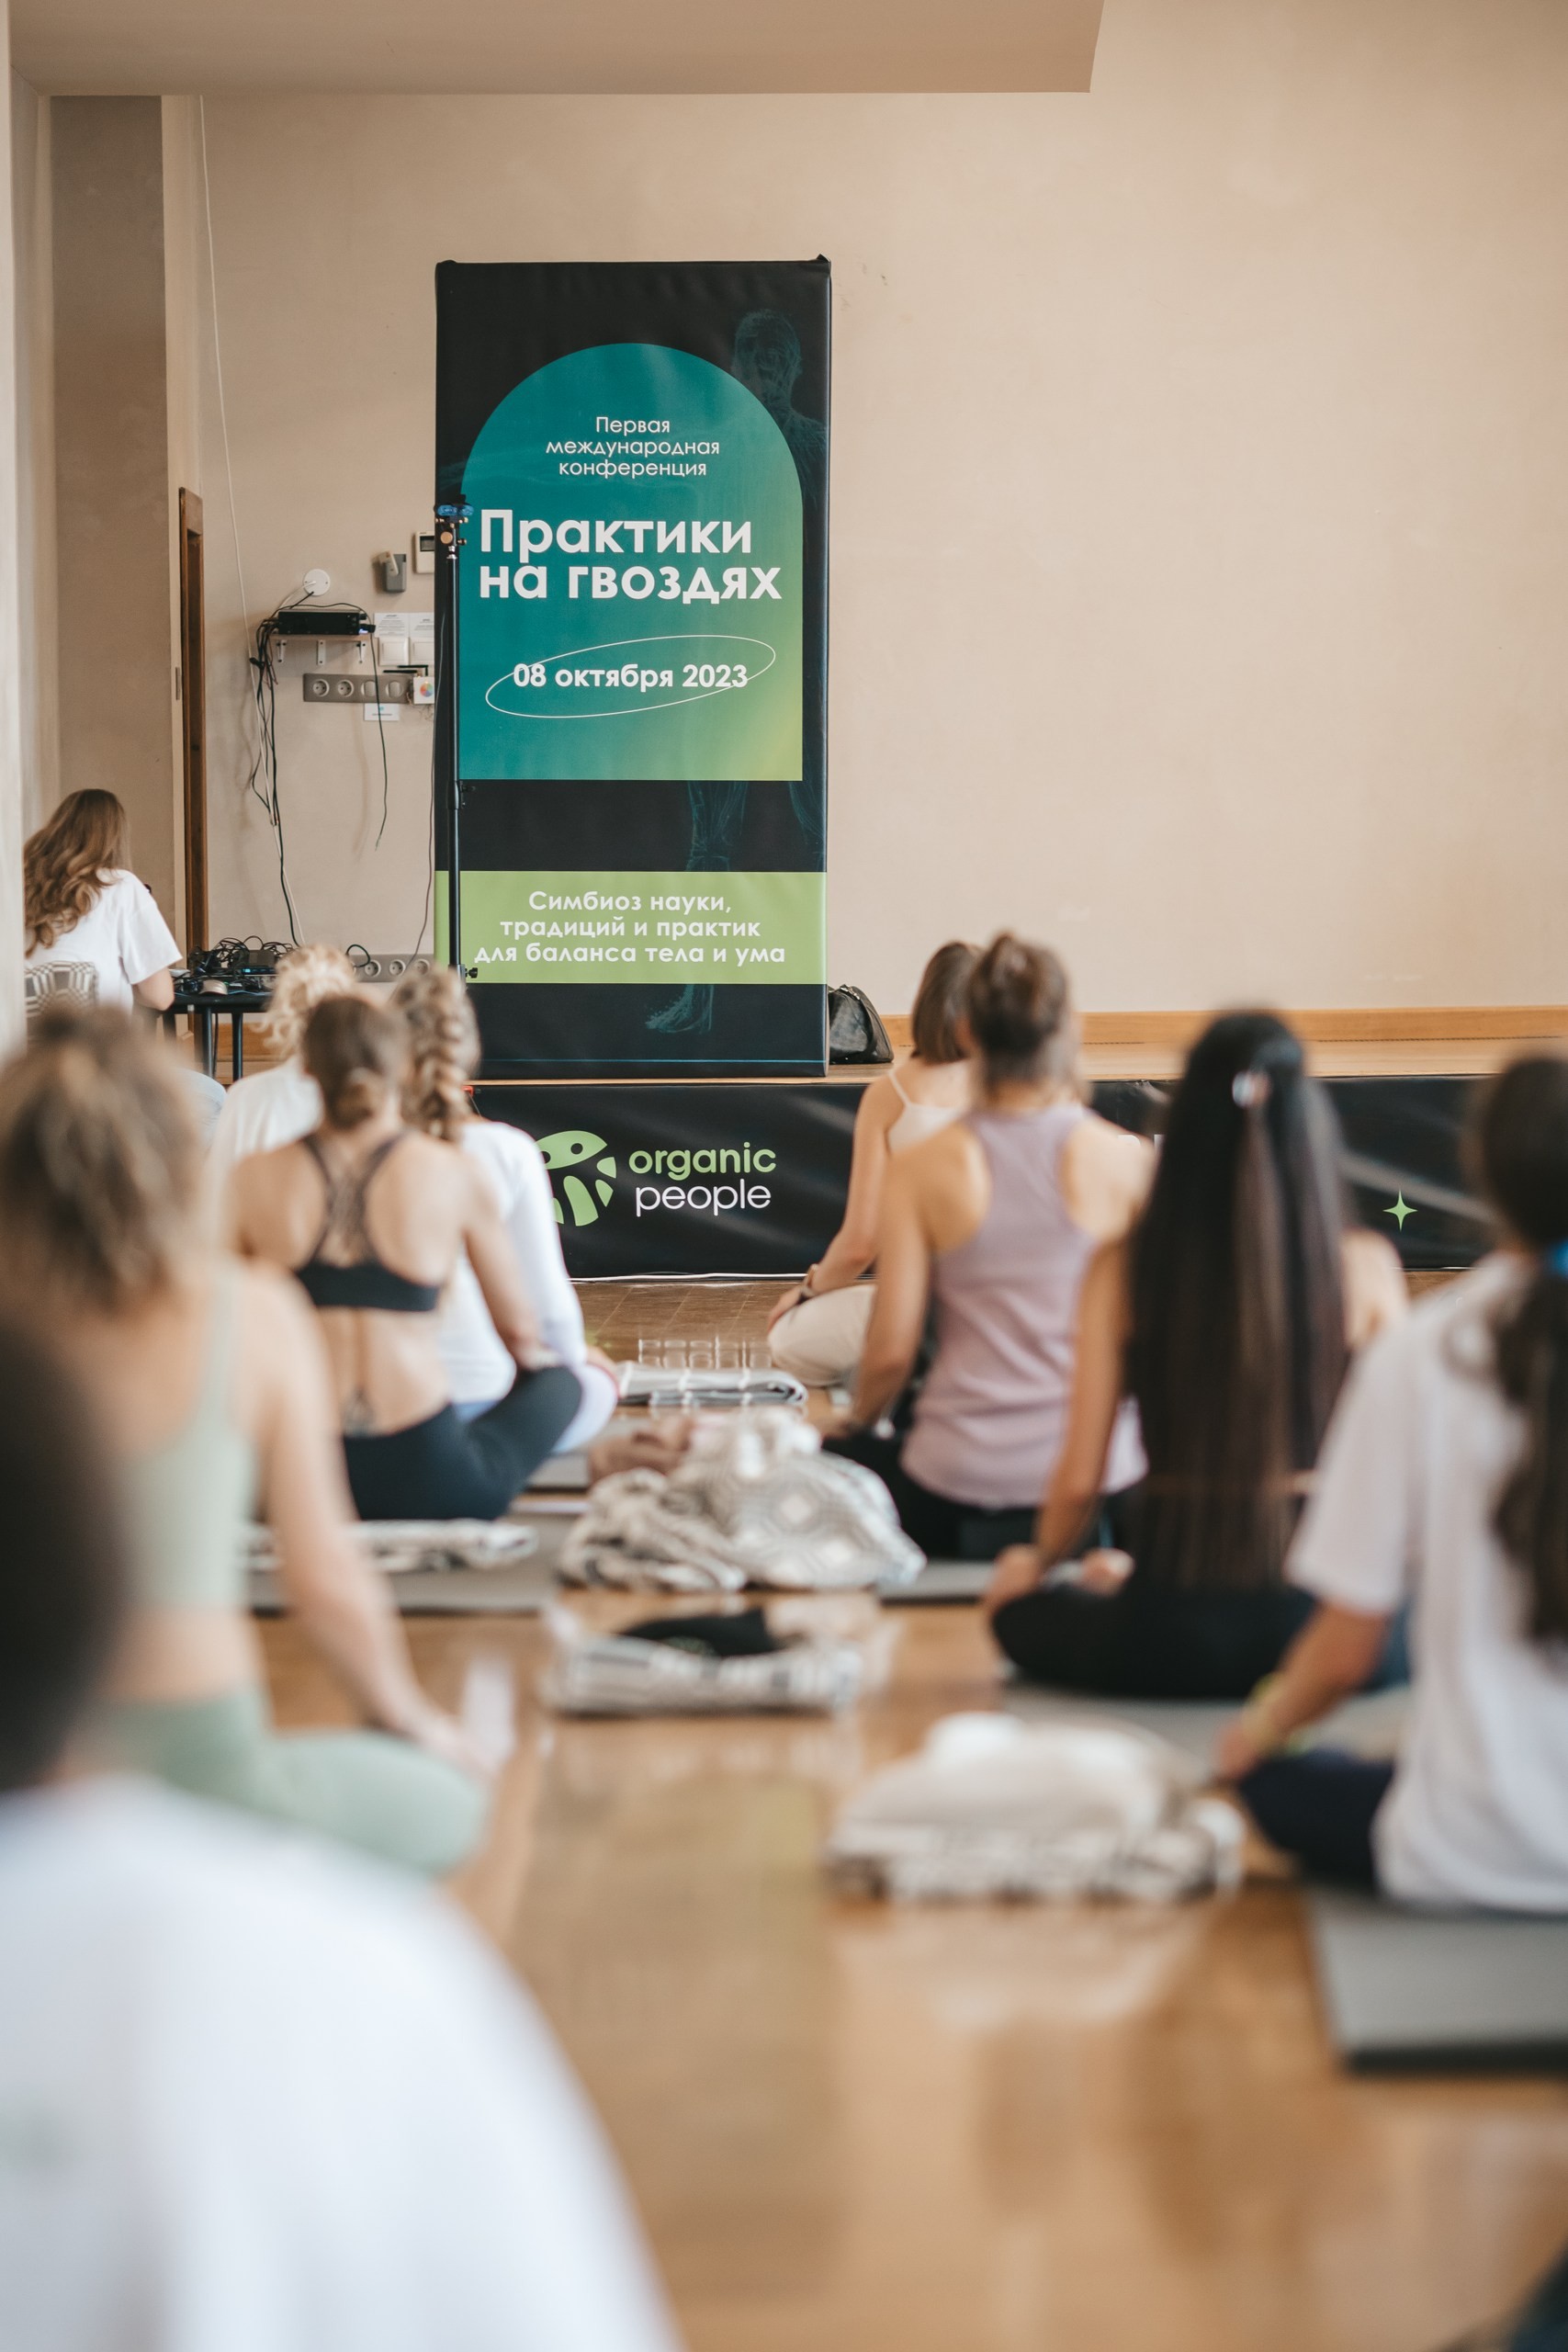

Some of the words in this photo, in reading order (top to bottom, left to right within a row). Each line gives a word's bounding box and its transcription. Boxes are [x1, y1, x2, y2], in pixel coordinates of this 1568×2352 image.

[596, 416, 670, 436] Первая
[546, 439, 719, 458] международная
[558, 459, 706, 479] конференция
[480, 509, 751, 563] Практики
[480, 565, 547, 599] на
[570, 567, 782, 604] гвоздях
[514, 664, 546, 687] 08
[556, 664, 673, 692] октября
[682, 665, 748, 688] 2023
[529, 891, 641, 910] Симбиоз
[650, 896, 731, 915] науки,
[500, 916, 625, 940] традиций
[634, 922, 647, 935] и
[658, 921, 760, 941] практик
[474, 946, 517, 964] для
[526, 943, 636, 962] баланса
[645, 947, 705, 963] тела
[714, 948, 727, 962] и
[737, 947, 785, 967] ума
[629, 1141, 776, 1181] organic
[636, 1179, 772, 1216] people
